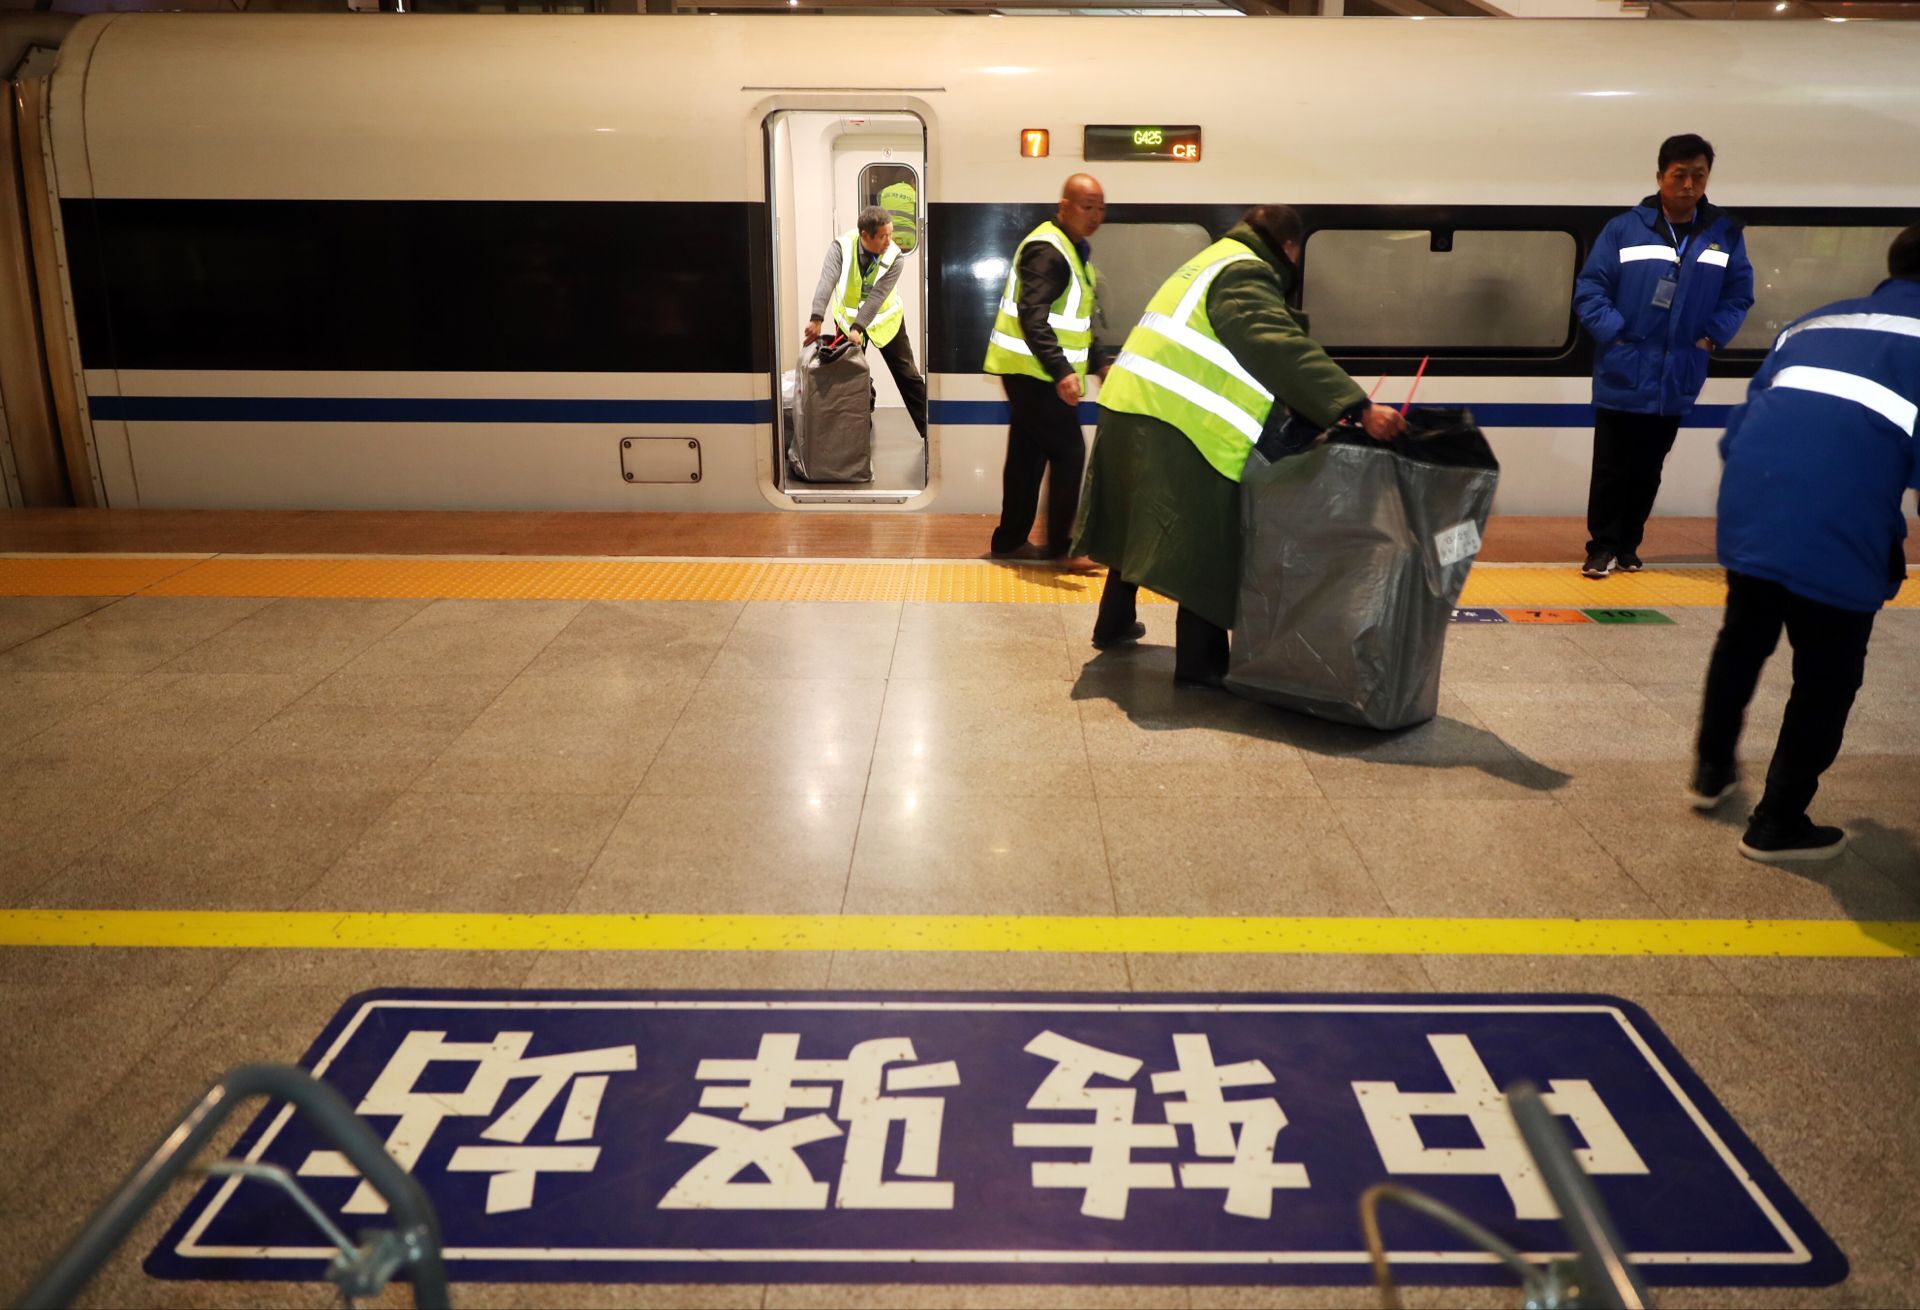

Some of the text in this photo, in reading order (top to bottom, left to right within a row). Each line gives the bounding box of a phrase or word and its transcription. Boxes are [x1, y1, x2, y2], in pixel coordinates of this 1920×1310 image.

[1027, 133, 1042, 157] 7
[1133, 130, 1163, 145] G425
[296, 1031, 1650, 1220] 中转驿站
